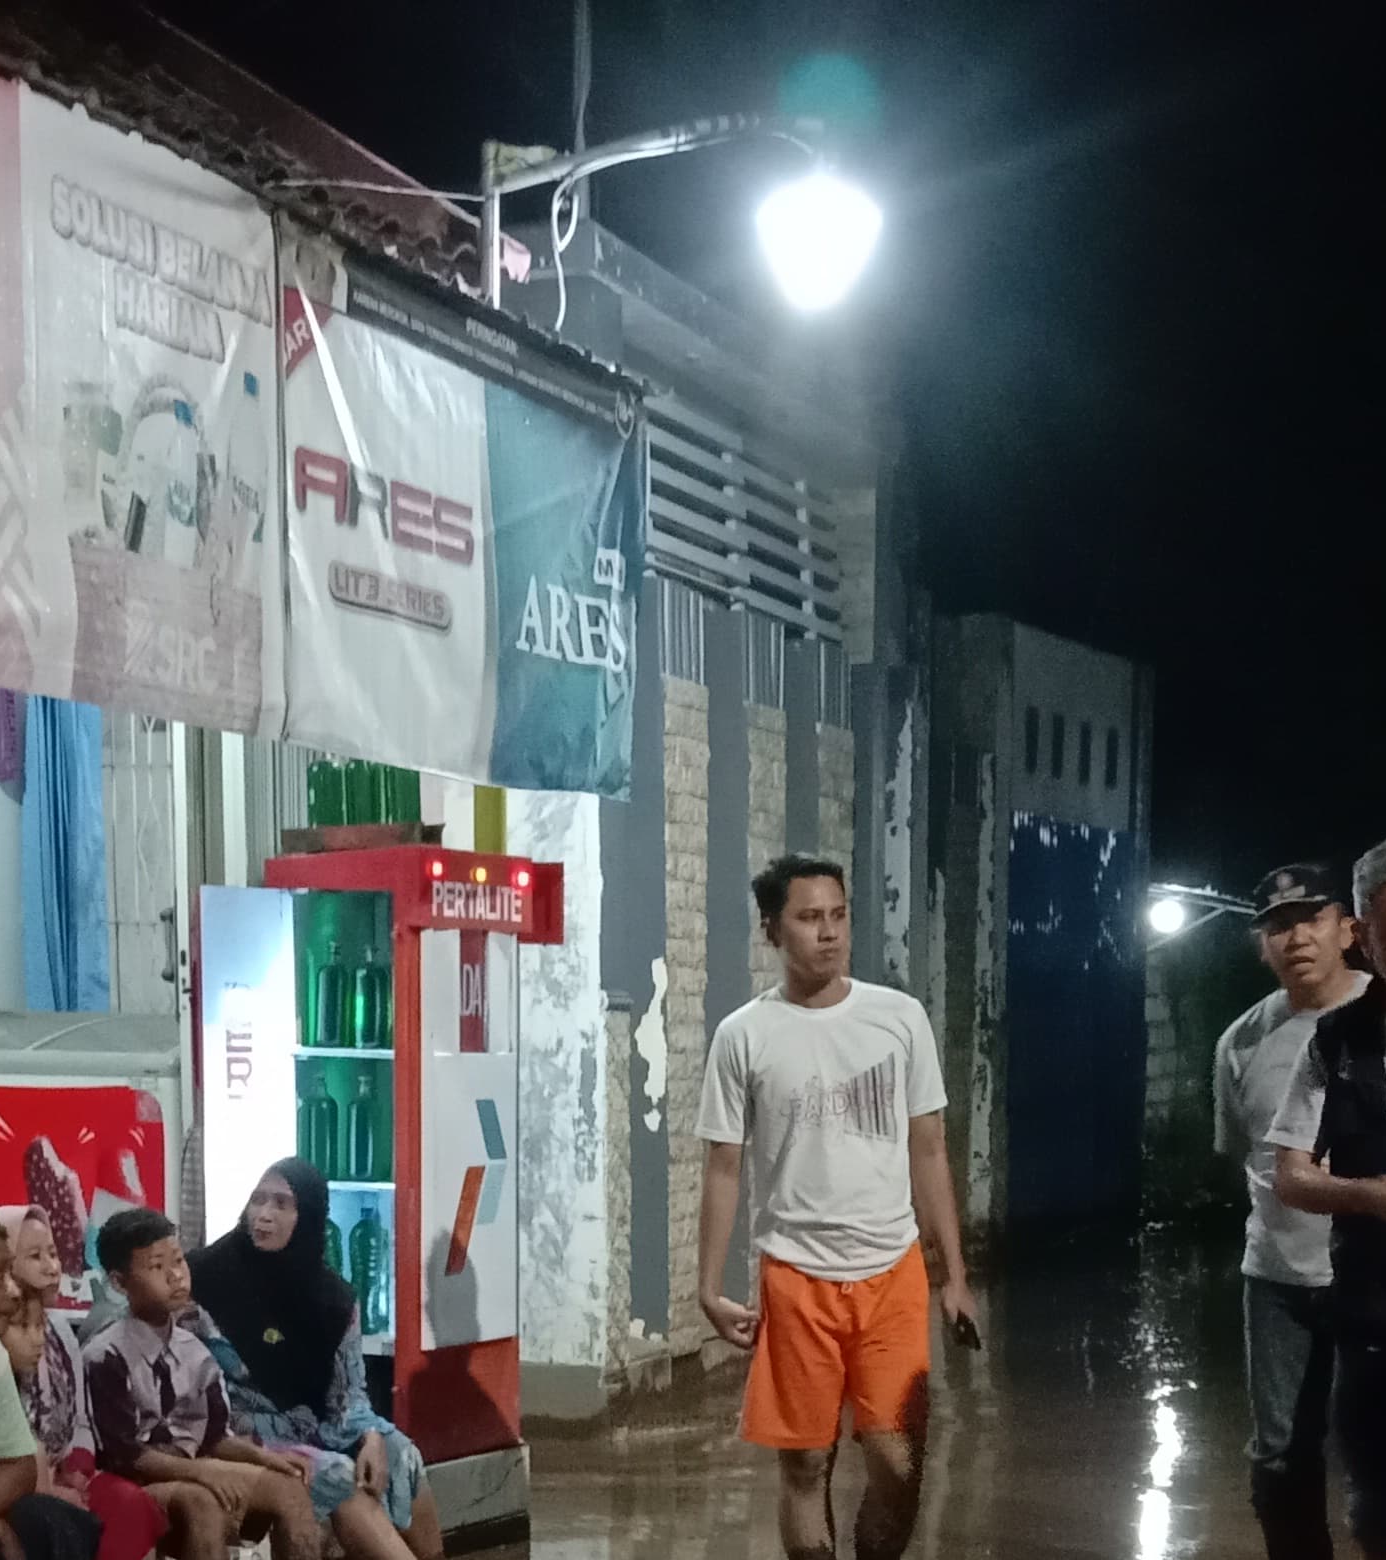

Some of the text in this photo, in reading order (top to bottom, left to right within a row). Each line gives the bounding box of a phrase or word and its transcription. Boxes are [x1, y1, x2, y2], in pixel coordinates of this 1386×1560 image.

[50, 173, 158, 277] SOLUSI
[113, 264, 227, 365] HARIAN
[294, 446, 475, 567] ARES
[515, 574, 627, 673] ARES
[431, 881, 523, 924] PERTALITE
